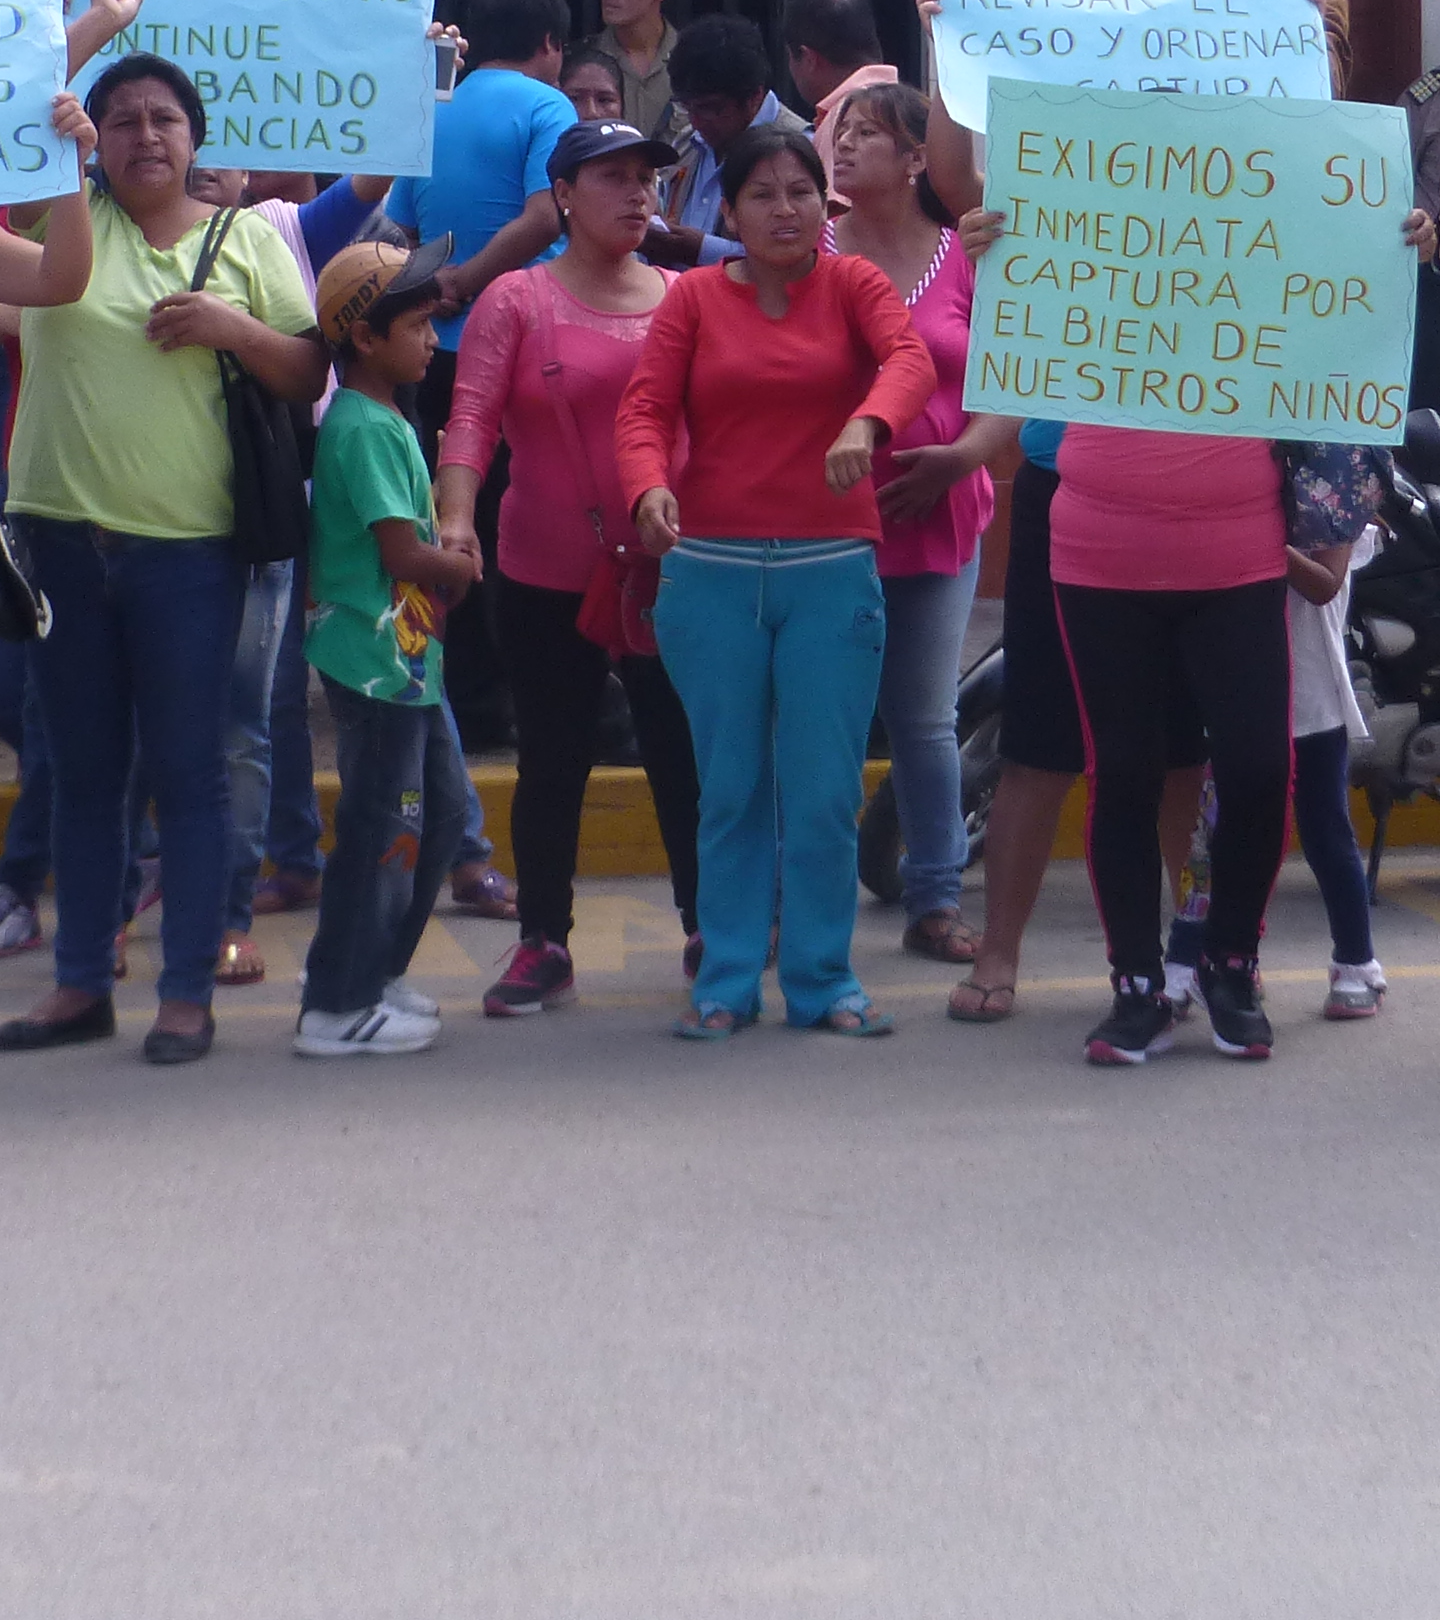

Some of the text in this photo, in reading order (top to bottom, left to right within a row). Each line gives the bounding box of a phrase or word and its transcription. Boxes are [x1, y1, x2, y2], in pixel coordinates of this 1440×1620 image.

[960, 26, 1074, 57] CASO
[1143, 23, 1324, 60] ORDENAR
[1017, 130, 1388, 208] EXIGIMOS SU
[1003, 196, 1282, 261] INMEDIATA
[1003, 255, 1374, 318] CAPTURA POR
[994, 300, 1288, 369] EL BIEN DE
[981, 351, 1405, 430] NUESTROS NIÑOS
